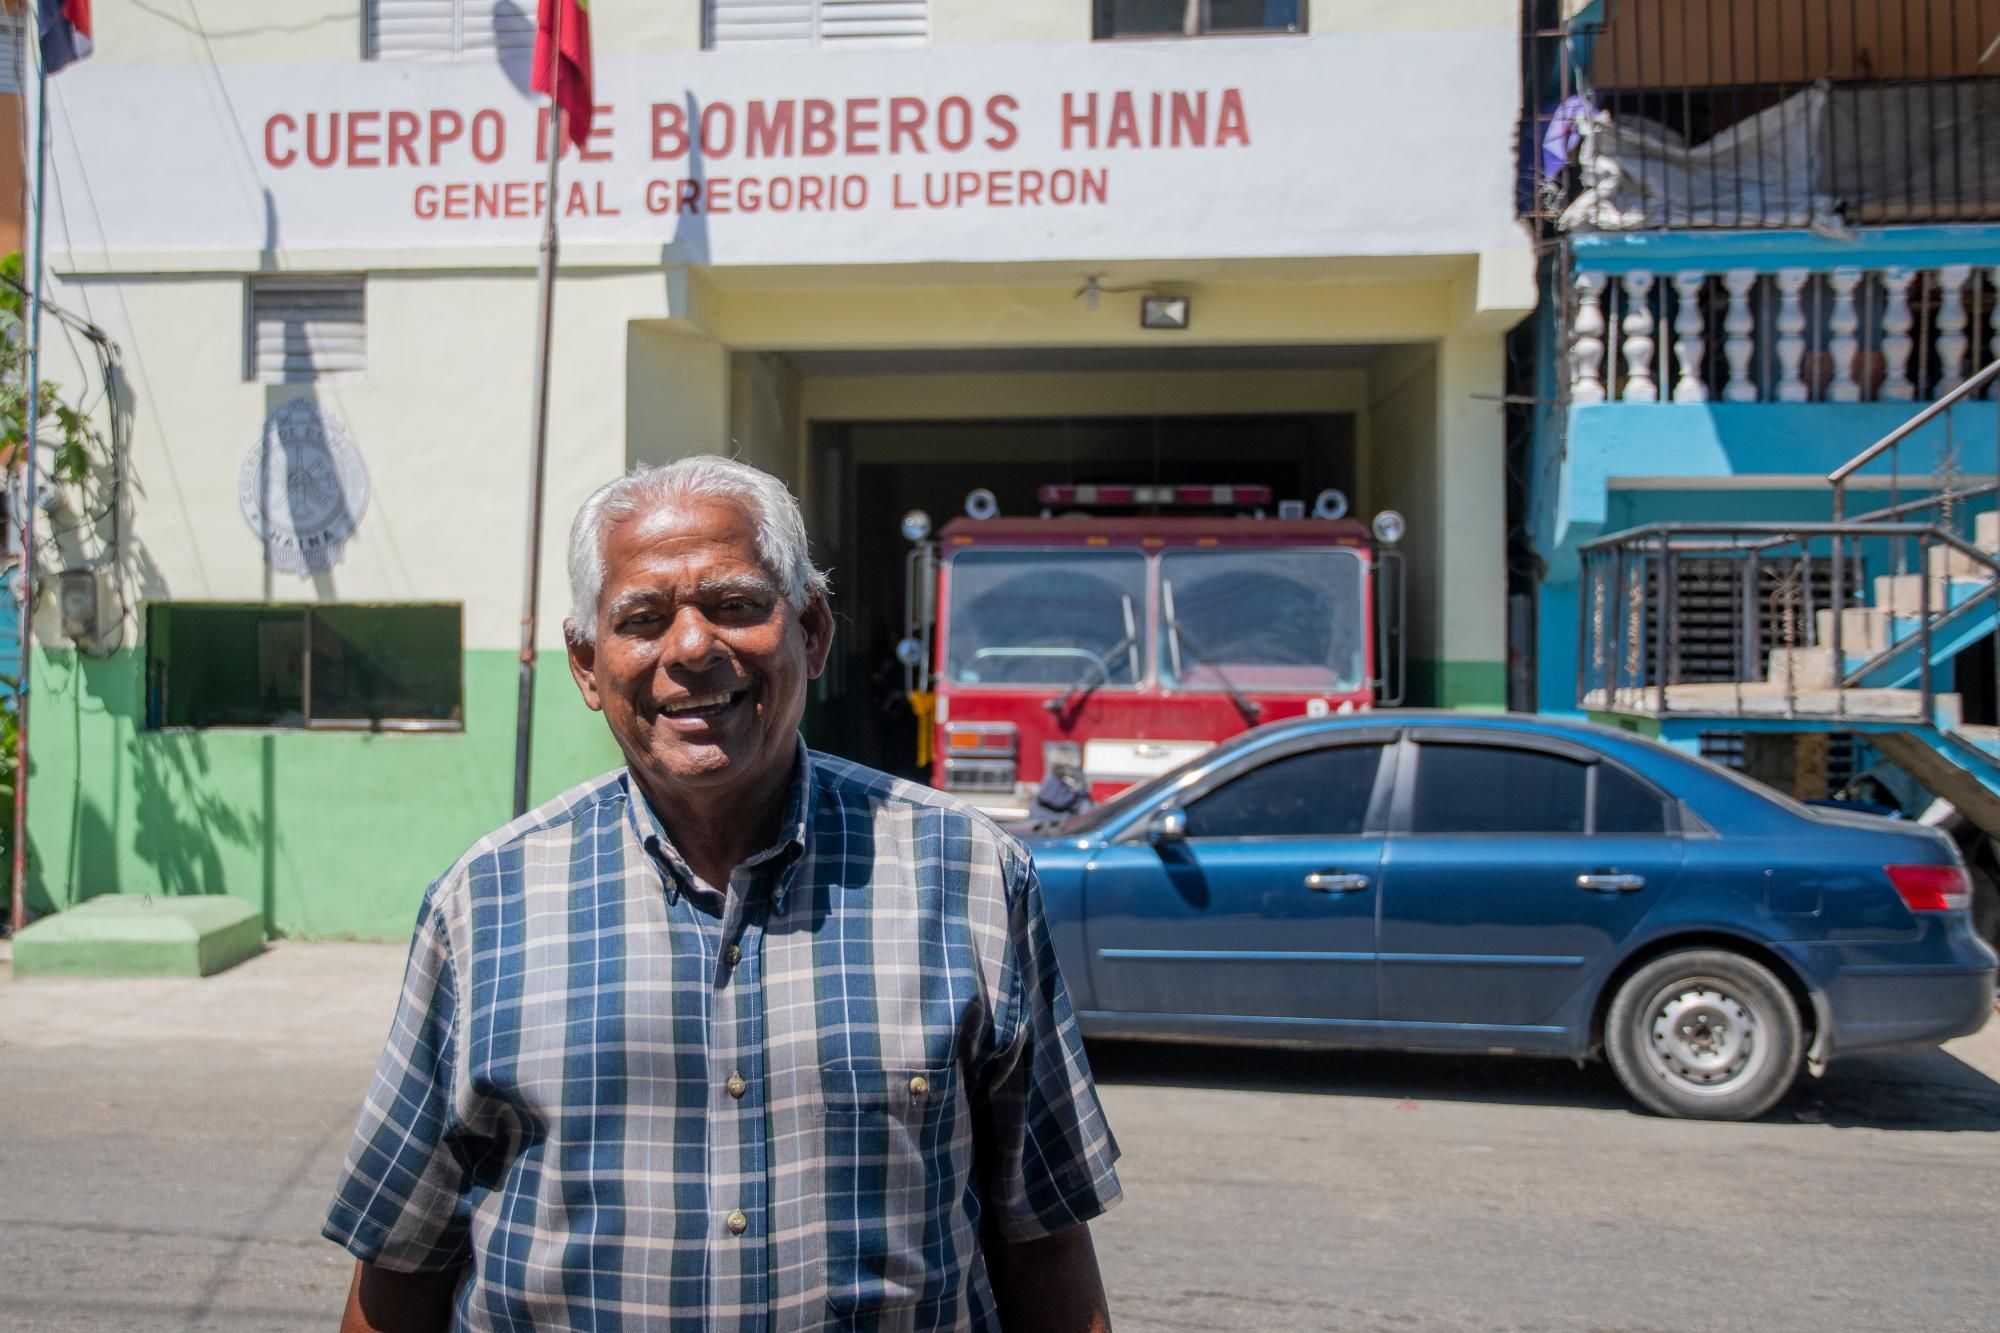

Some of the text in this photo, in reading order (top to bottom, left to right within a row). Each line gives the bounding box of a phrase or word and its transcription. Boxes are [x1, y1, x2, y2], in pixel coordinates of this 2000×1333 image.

[264, 88, 1250, 170] CUERPO DE BOMBEROS HAINA
[645, 175, 868, 216] GREGORIO
[893, 168, 1108, 210] LUPERON
[270, 529, 336, 550] HAINA
